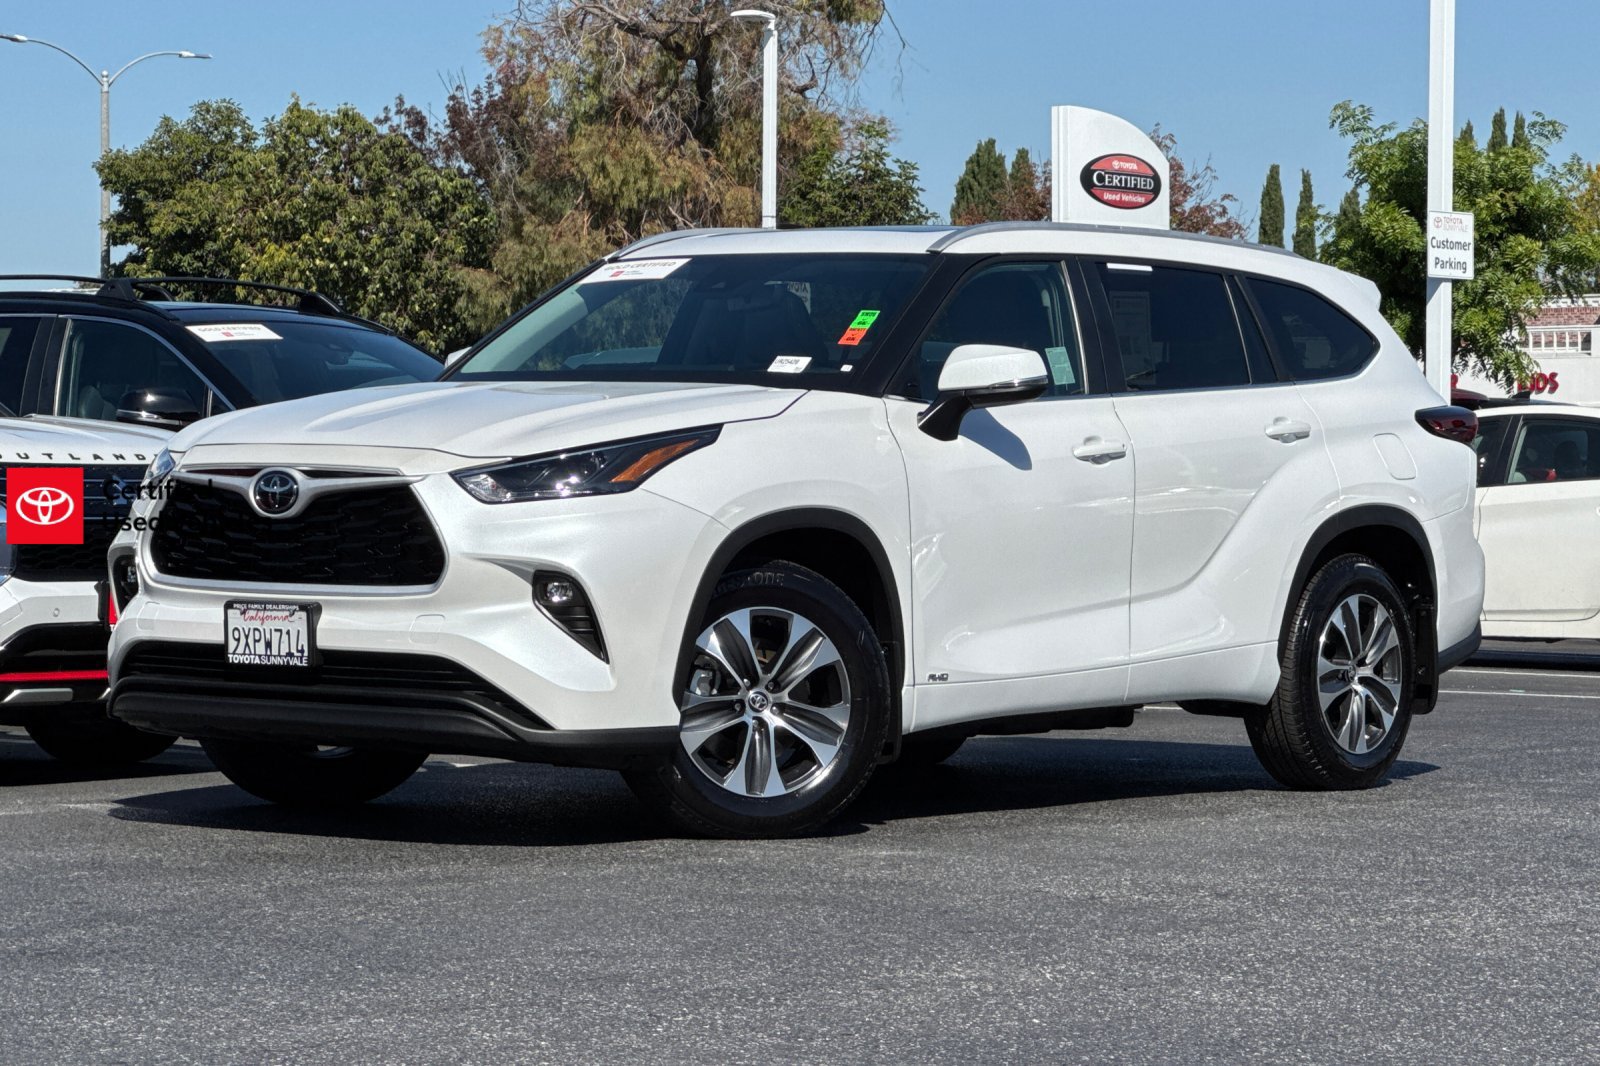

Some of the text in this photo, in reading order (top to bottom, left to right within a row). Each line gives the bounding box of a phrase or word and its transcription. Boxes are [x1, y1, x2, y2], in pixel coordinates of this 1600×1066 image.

[1119, 161, 1138, 170] TOYOTA
[1092, 170, 1154, 190] CERTIFIED
[1103, 192, 1145, 203] Used Vehicles
[1443, 216, 1463, 225] TOYOTA
[1430, 236, 1472, 251] Customer
[1434, 256, 1467, 274] Parking
[231, 626, 305, 656] 9XPW714
